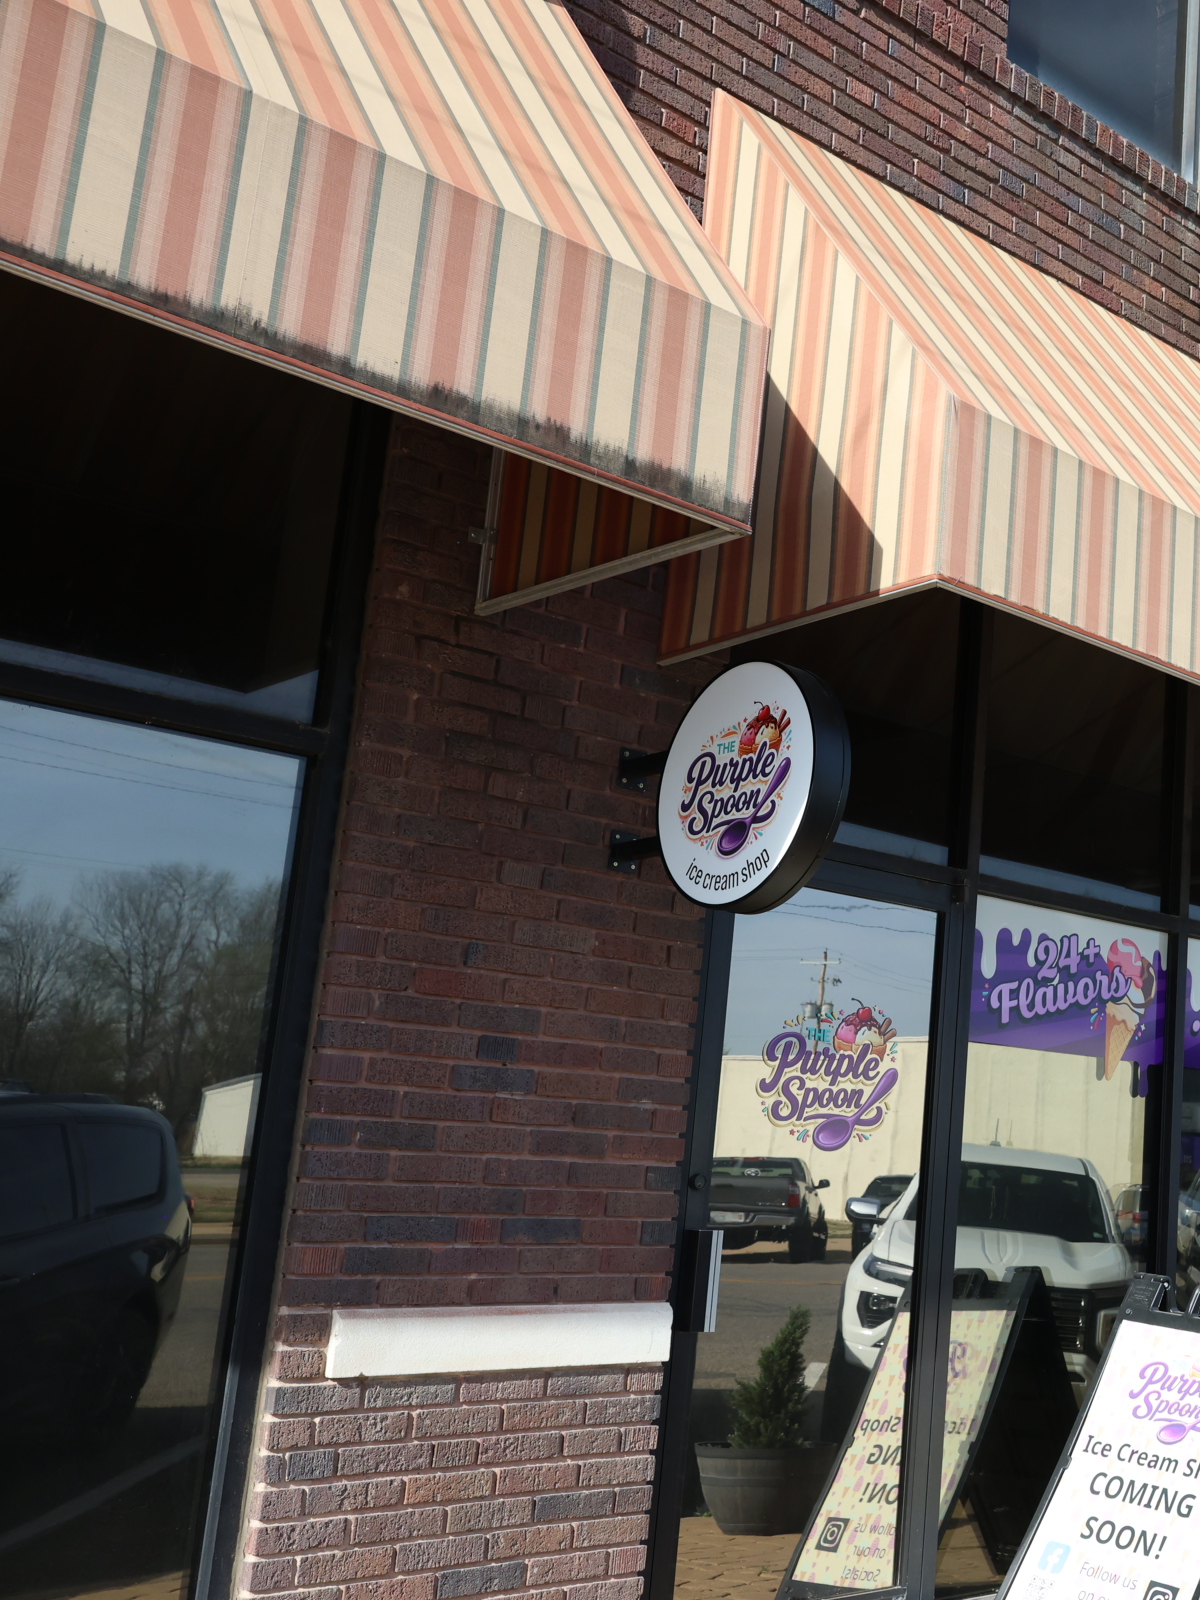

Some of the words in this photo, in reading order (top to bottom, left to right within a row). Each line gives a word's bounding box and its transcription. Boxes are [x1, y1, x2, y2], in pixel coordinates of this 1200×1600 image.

[717, 740, 736, 755] THE
[680, 739, 776, 813] Purple
[687, 787, 762, 836] Spoon
[685, 858, 702, 885] ice
[702, 872, 740, 892] cream
[741, 848, 771, 883] shop
[1036, 933, 1101, 982] 24+
[990, 966, 1132, 1024] Flavors
[806, 1027, 832, 1042] THE
[758, 1031, 880, 1093] Purple
[770, 1075, 866, 1122] Spoon
[1082, 1434, 1112, 1458] Ice
[1116, 1443, 1179, 1474] Cream
[1088, 1471, 1197, 1519] COMING
[1079, 1515, 1168, 1560] SOON!
[1079, 1561, 1120, 1585] Follow
[1122, 1577, 1138, 1590] us
